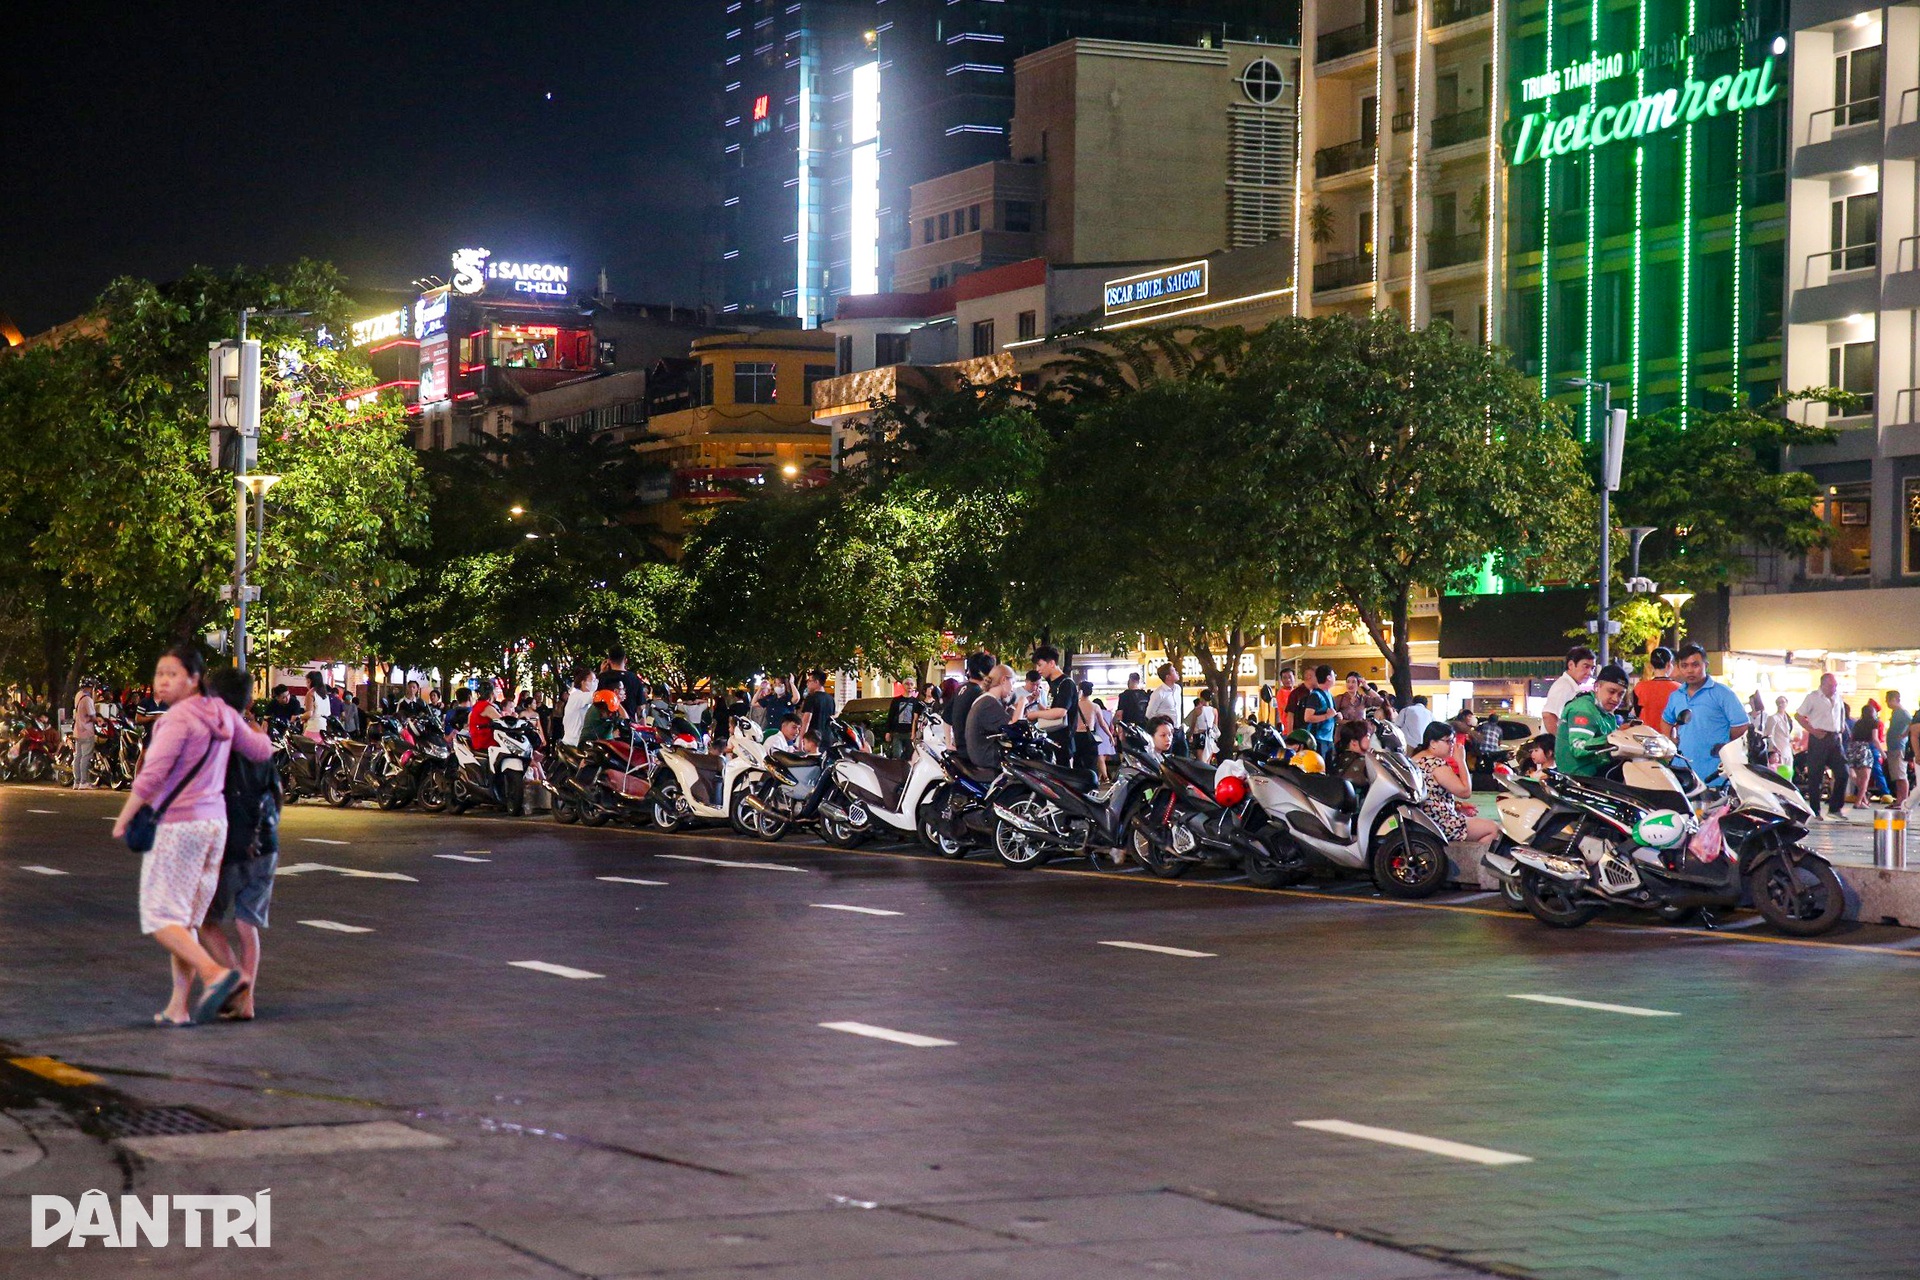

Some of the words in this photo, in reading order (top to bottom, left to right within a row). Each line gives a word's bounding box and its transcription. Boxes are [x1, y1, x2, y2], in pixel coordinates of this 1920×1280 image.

[1521, 70, 1561, 102] TRUNG
[1563, 58, 1592, 91] TÂM
[1594, 52, 1623, 83] GIAO
[498, 261, 569, 283] SAIGON
[514, 280, 568, 295] CHILL
[1106, 285, 1133, 306] OSCAR
[1136, 278, 1164, 300] HOTEL
[1166, 269, 1201, 293] SAIGON
